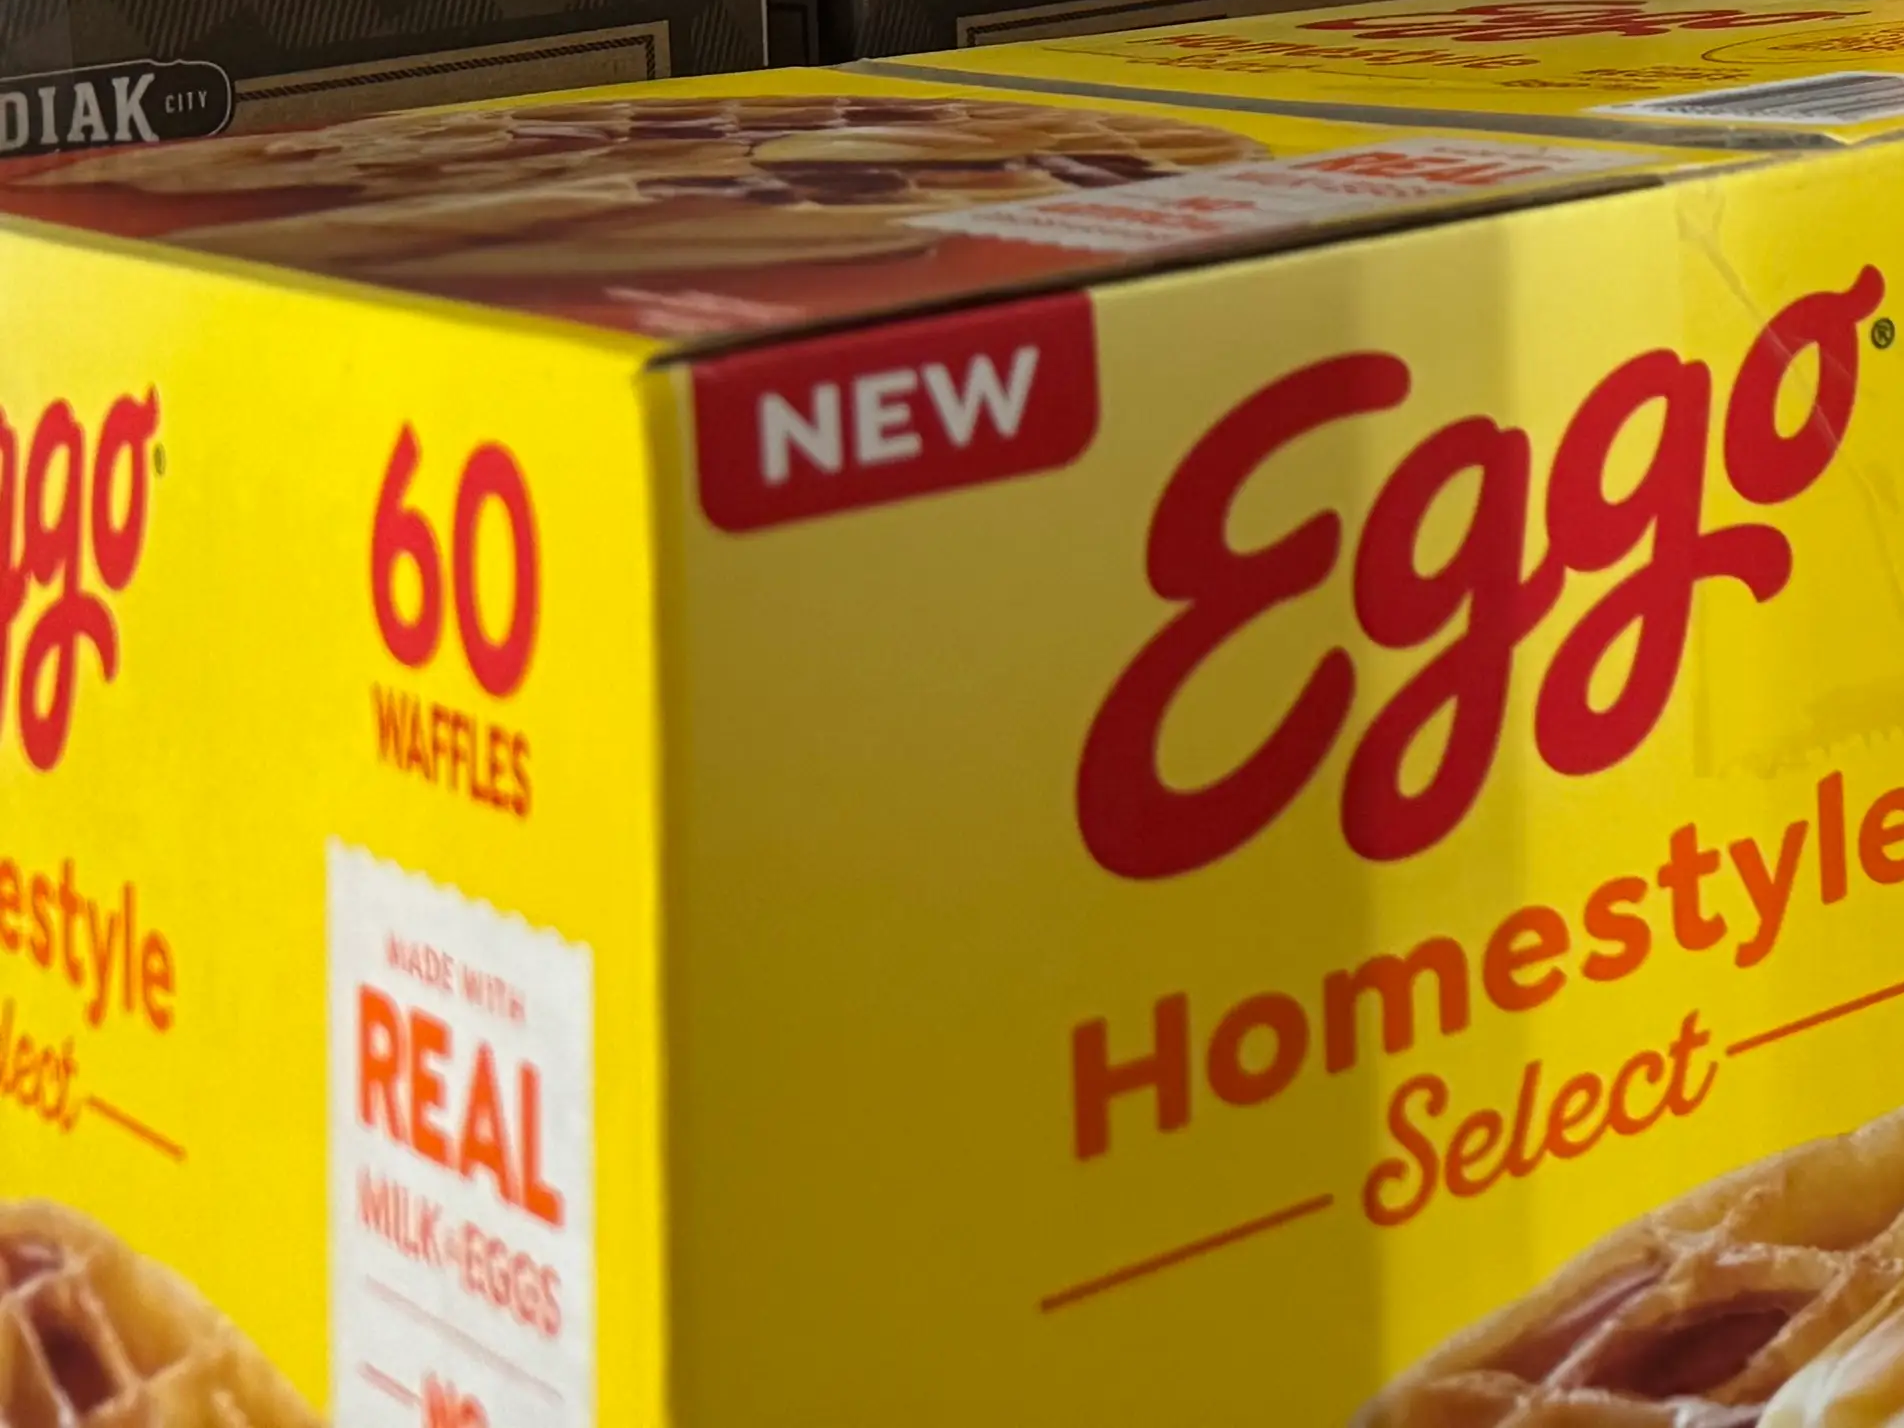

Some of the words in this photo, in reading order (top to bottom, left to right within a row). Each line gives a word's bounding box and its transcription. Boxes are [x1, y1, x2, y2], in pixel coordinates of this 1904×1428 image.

[0, 73, 160, 150] DIAK
[165, 90, 208, 114] CITY
[766, 346, 1036, 482] NEW
[370, 418, 542, 700] 60
[371, 682, 531, 821] WAFFLES
[356, 981, 566, 1231] REAL
[1366, 1012, 1715, 1225] Select
